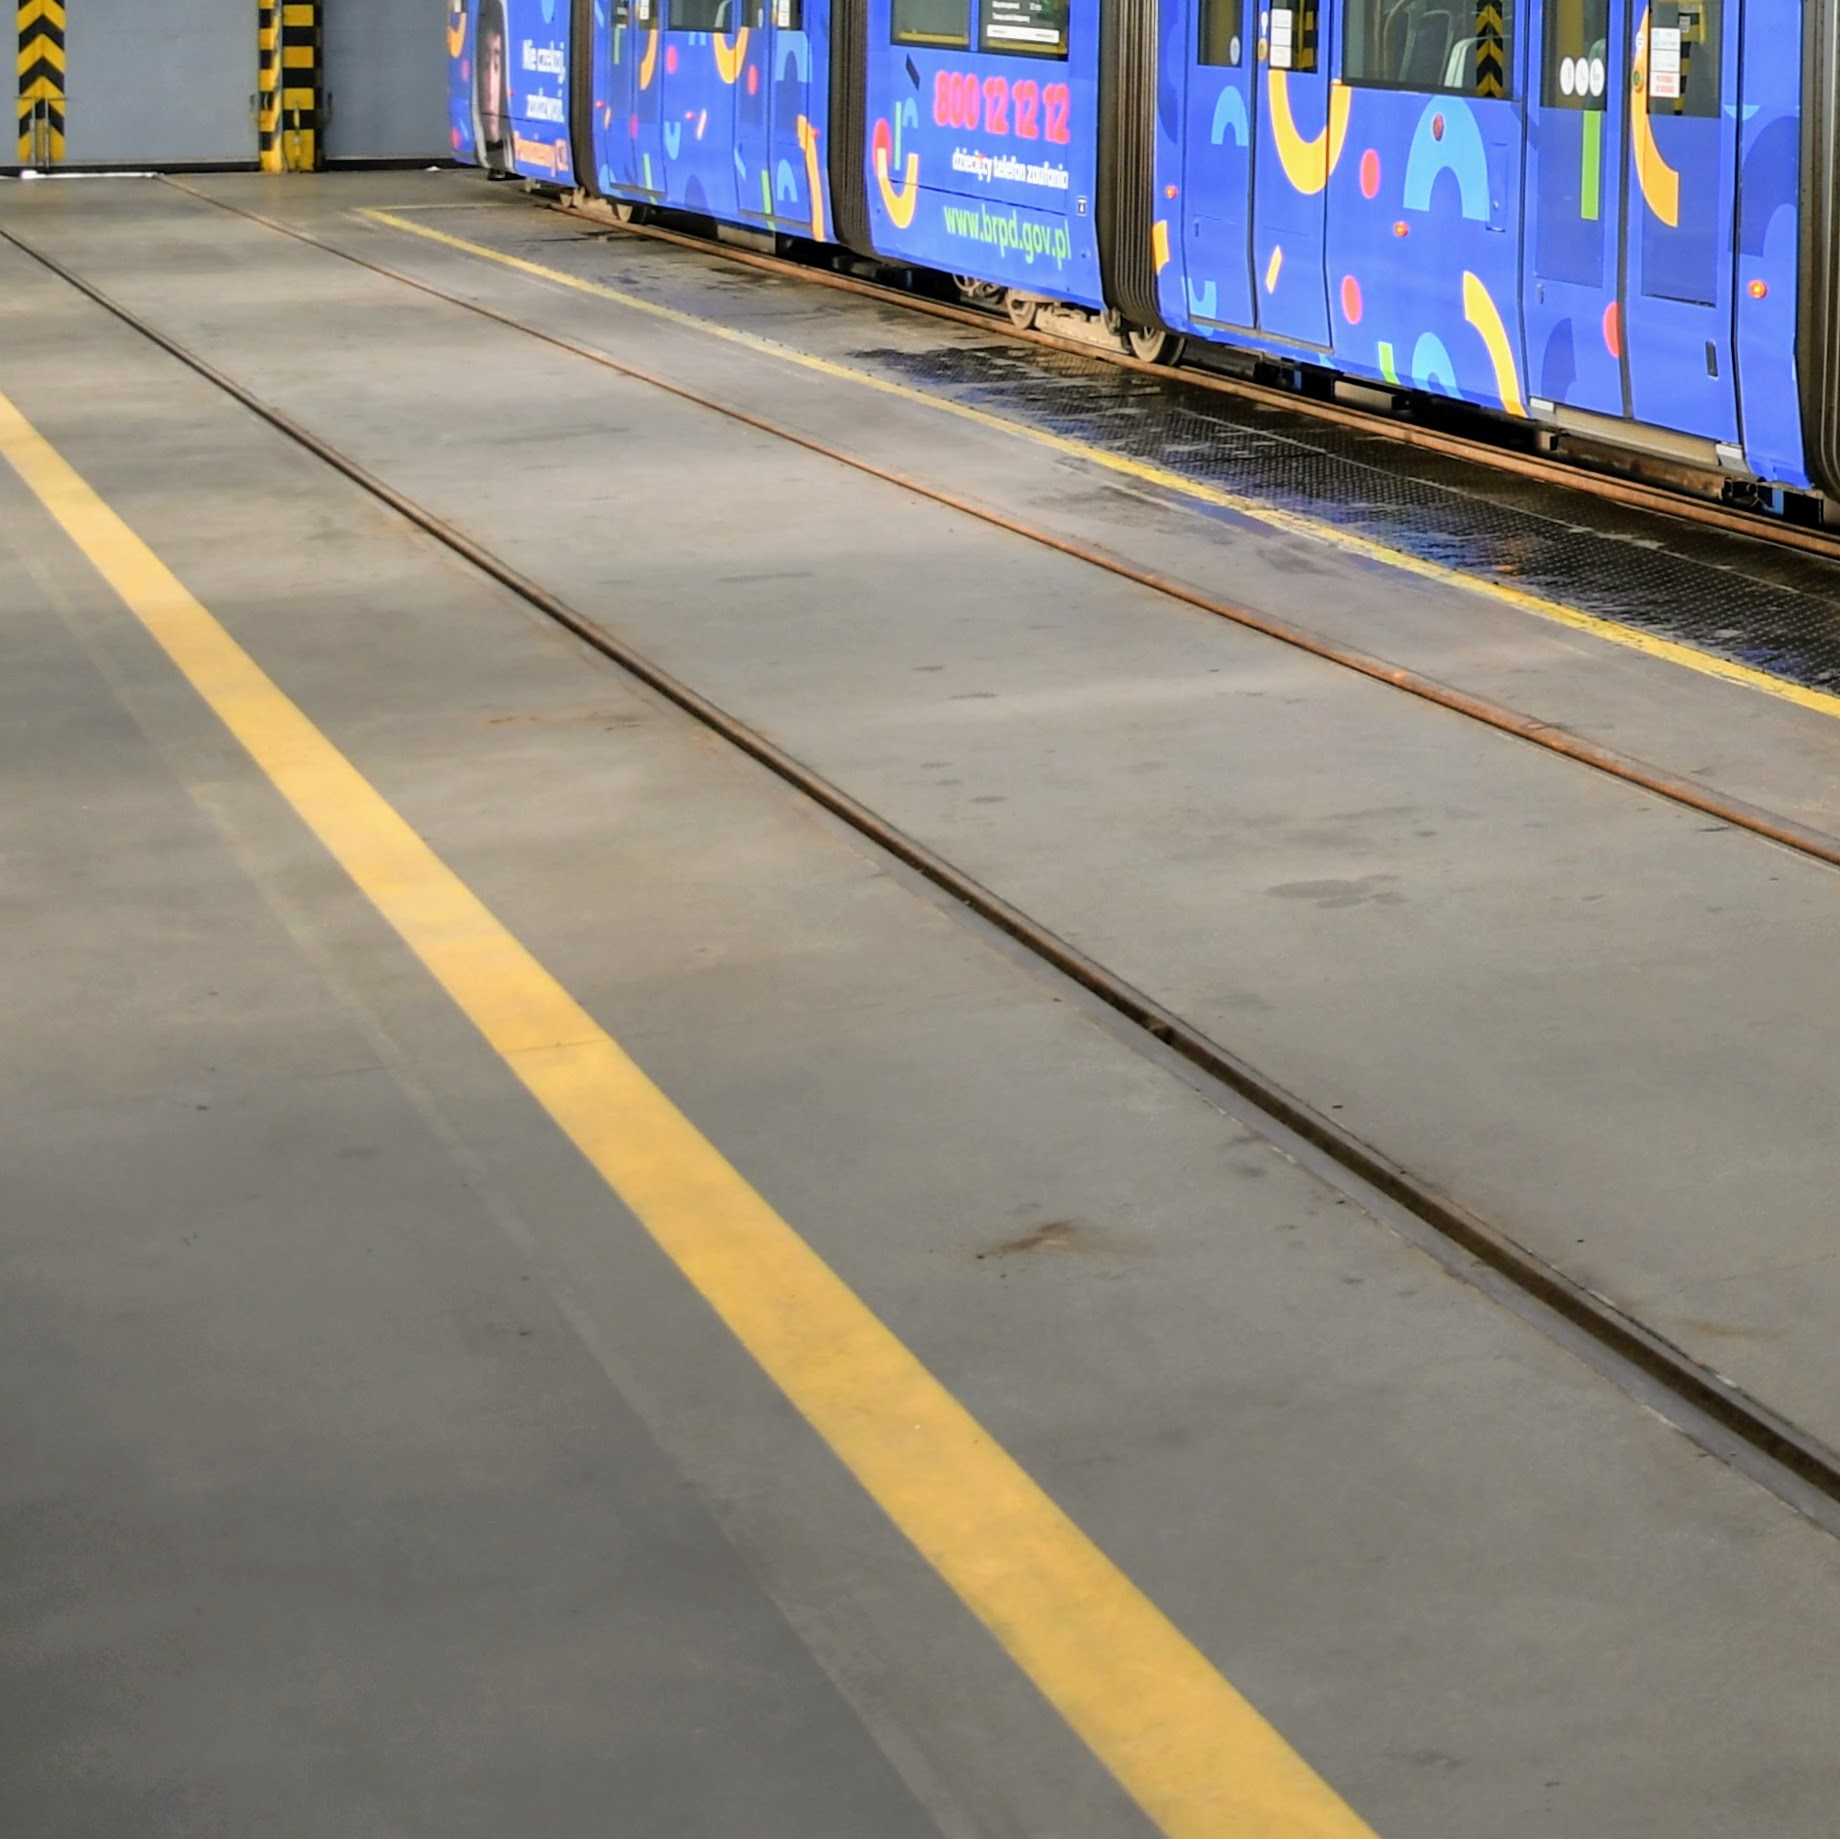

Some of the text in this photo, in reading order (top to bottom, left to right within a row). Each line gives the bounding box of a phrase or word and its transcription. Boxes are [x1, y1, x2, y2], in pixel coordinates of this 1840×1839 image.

[935, 70, 1070, 144] 800 12 12 12
[944, 203, 1071, 270] www.brpd.gov.pl
